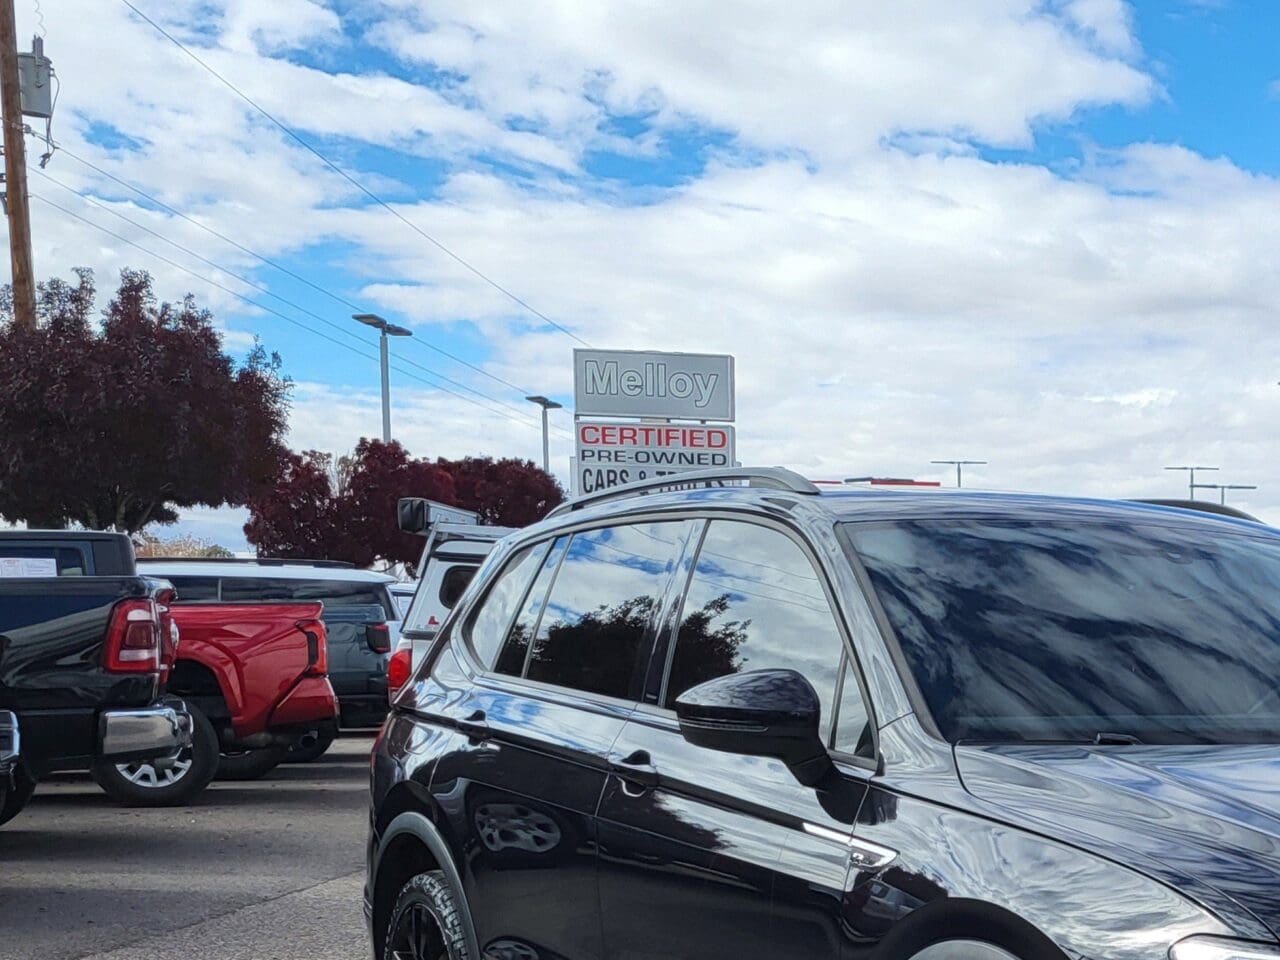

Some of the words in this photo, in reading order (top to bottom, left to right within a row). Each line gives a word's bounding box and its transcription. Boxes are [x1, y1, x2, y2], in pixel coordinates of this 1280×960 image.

[585, 360, 719, 408] Melloy
[581, 426, 727, 448] CERTIFIED
[581, 450, 727, 466] PRE-OWNED
[583, 468, 629, 493] CARS
